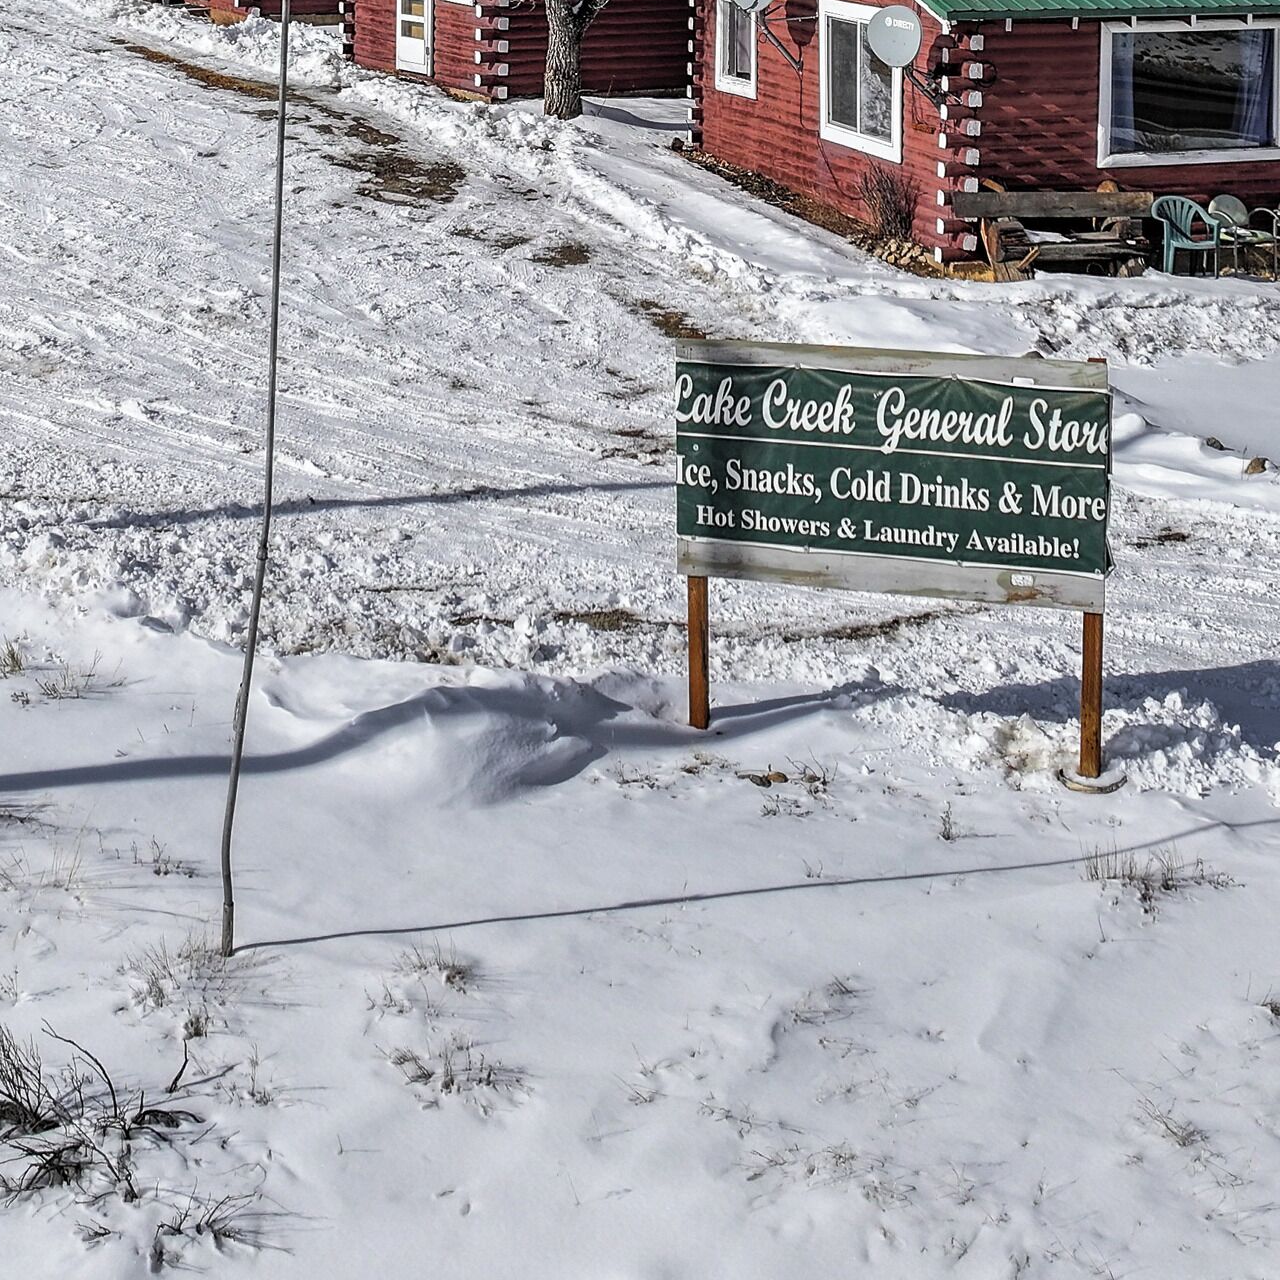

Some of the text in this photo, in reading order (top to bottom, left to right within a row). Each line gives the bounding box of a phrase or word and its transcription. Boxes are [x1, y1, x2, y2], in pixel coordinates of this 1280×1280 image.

[675, 373, 752, 426] Lake
[762, 378, 856, 435] Creek
[877, 387, 1014, 454] General
[676, 455, 1106, 521] Ice, Snacks, Cold Drinks & More
[696, 505, 1081, 559] Hot Showers & Laundry Available!
